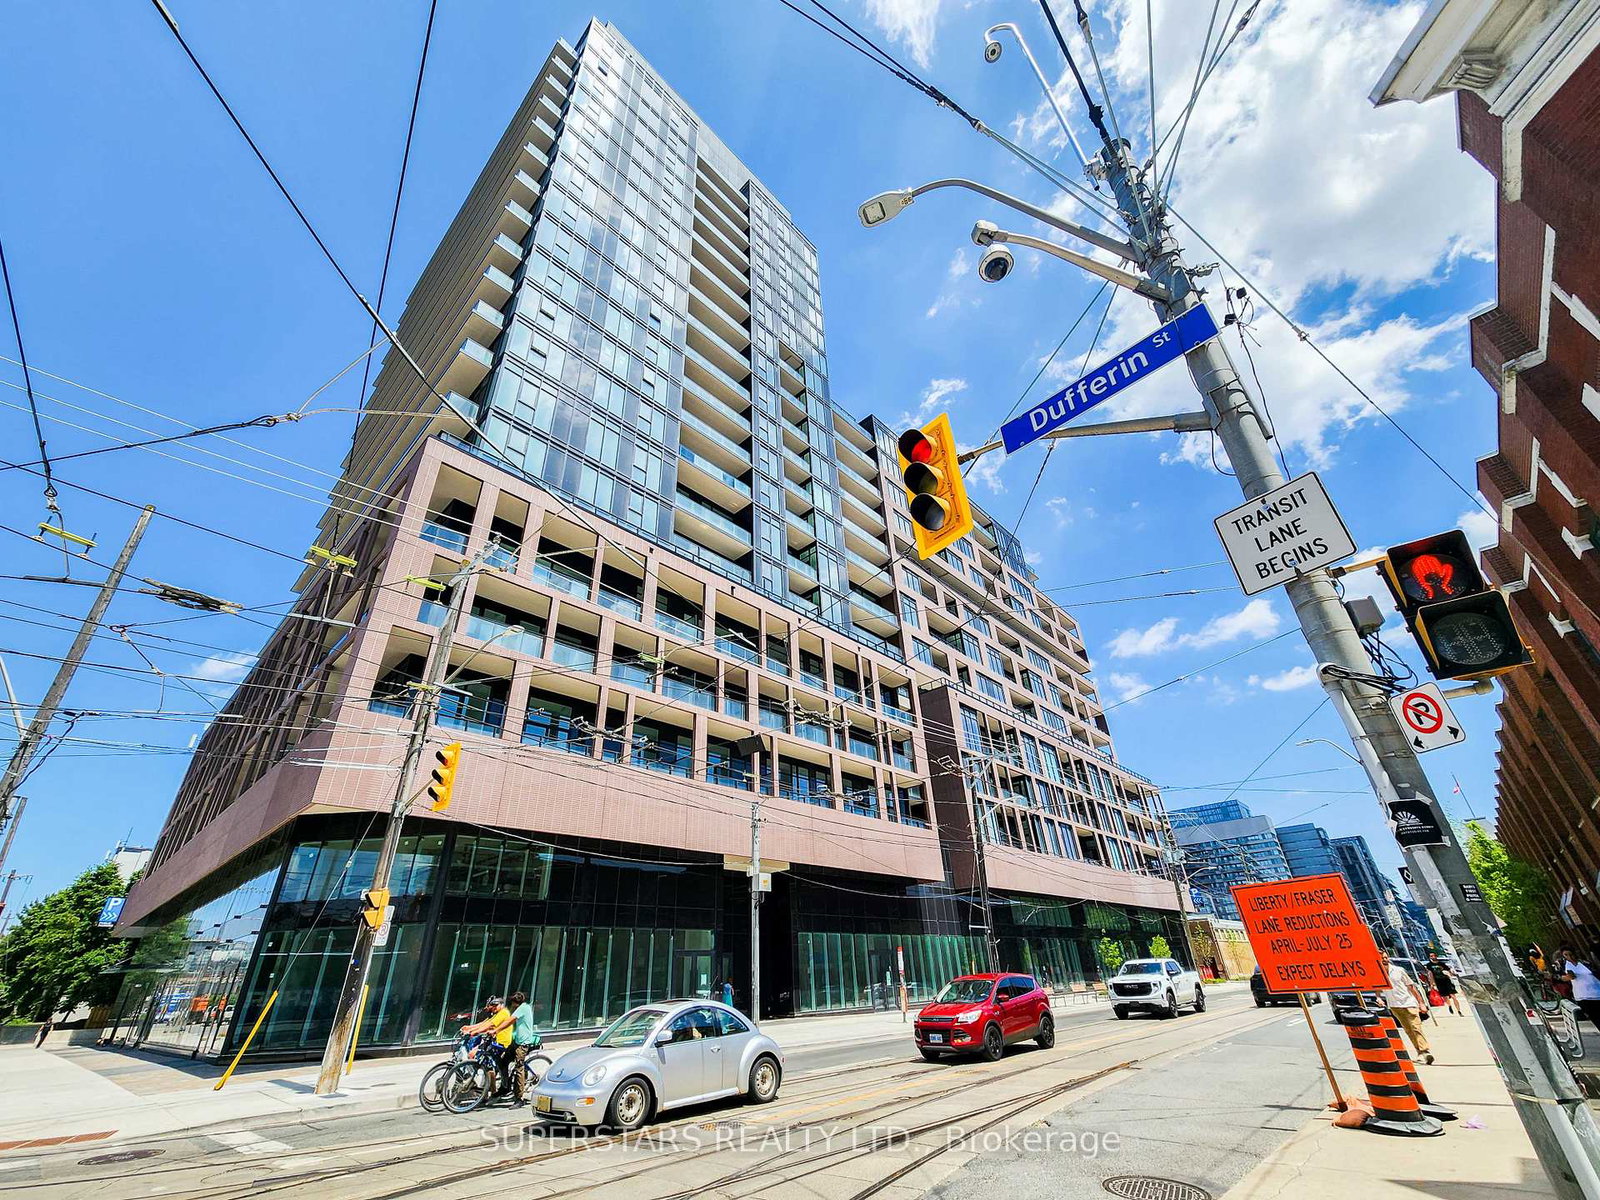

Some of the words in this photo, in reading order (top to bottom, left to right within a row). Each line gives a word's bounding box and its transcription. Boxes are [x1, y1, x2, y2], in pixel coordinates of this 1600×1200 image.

[1029, 351, 1149, 432] Dufferin
[1152, 331, 1171, 348] St
[1231, 488, 1308, 535] TRANSIT
[1254, 517, 1307, 552] LANE
[1255, 537, 1328, 579] BEGINS
[107, 898, 122, 910] P
[1254, 917, 1283, 934] LANE
[1284, 911, 1350, 931] REDUCTIONS
[1335, 933, 1353, 949] 25
[1276, 963, 1318, 981] EXPECT
[1321, 960, 1366, 979] DELAYS
